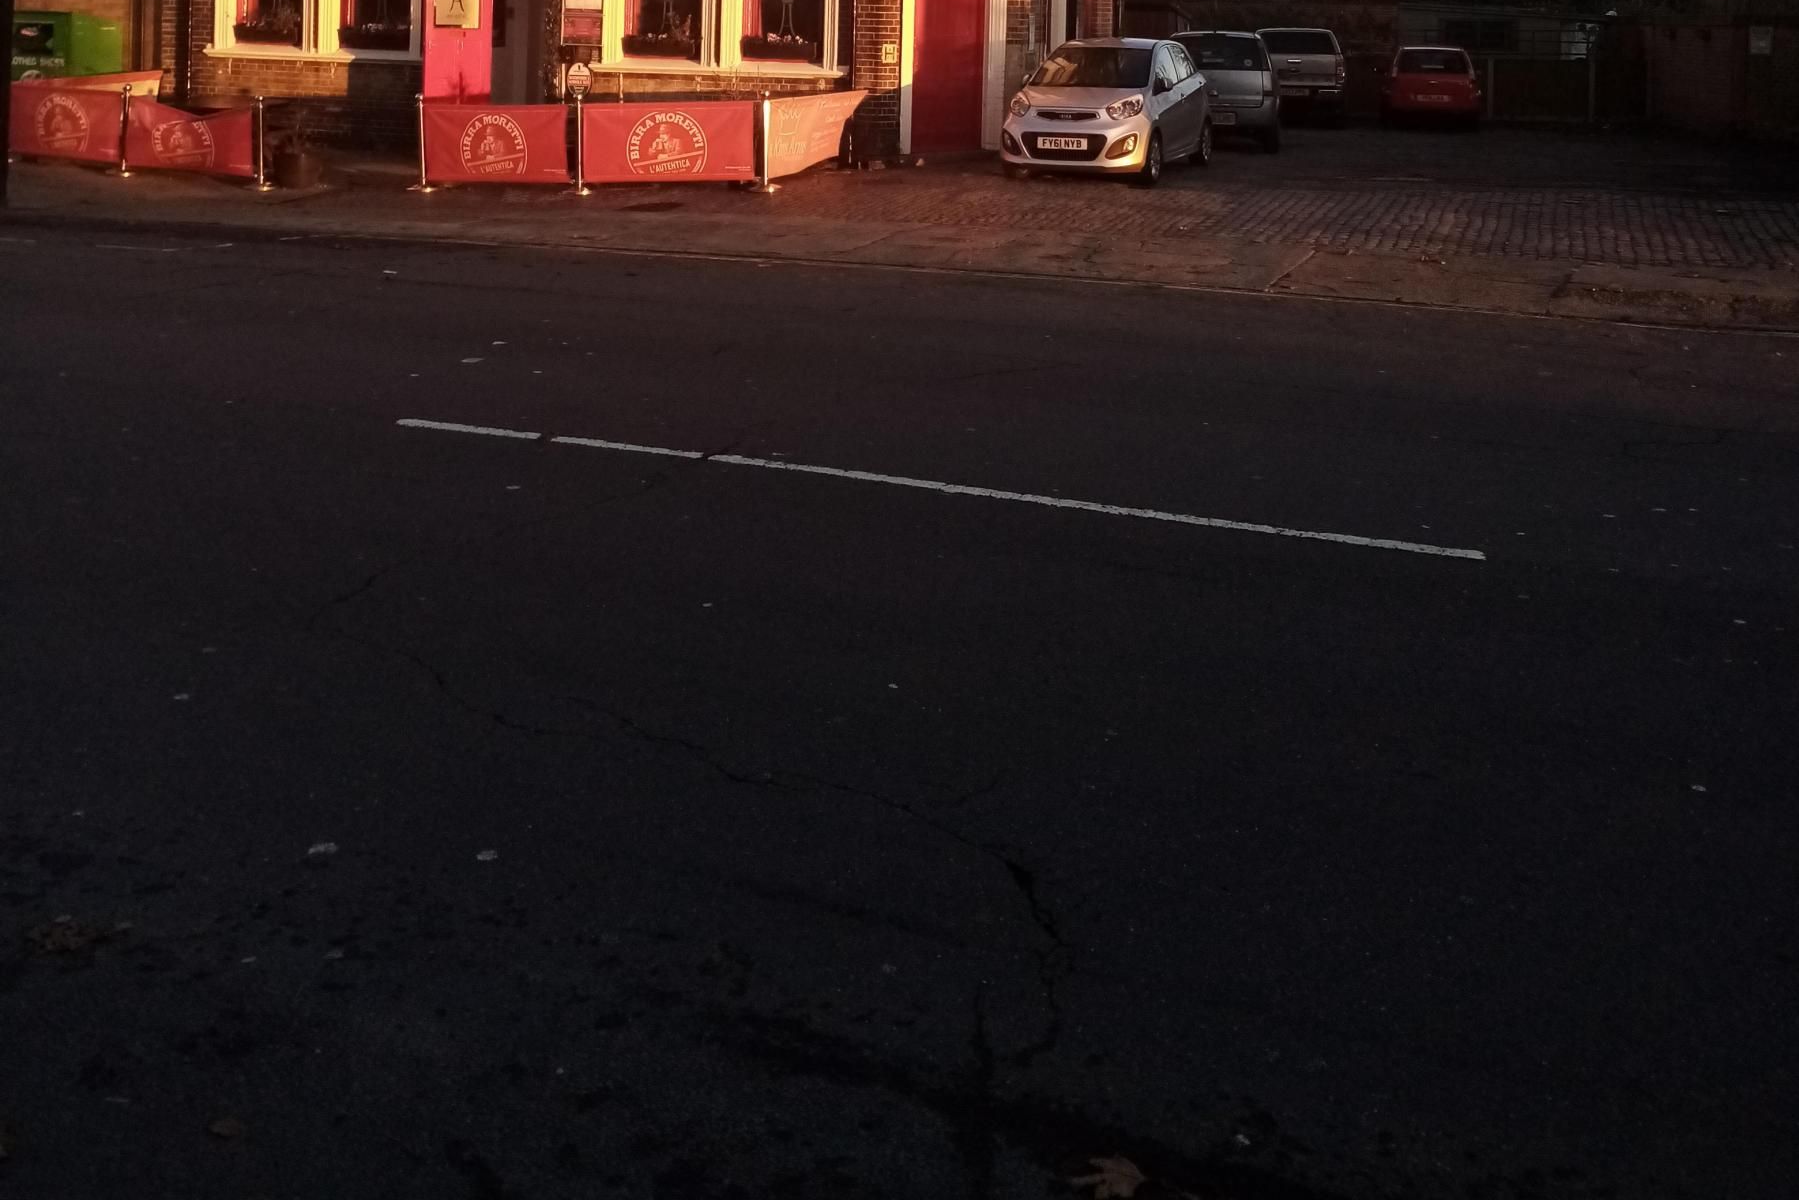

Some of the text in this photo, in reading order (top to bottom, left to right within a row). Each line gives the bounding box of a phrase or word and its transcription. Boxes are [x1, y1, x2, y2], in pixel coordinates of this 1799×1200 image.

[463, 115, 524, 160] BIRRA MORETTI
[630, 112, 704, 161] BIRRA MORETTI
[1042, 138, 1082, 149] FY61 NYB
[649, 159, 691, 173] L'AUTENTICA
